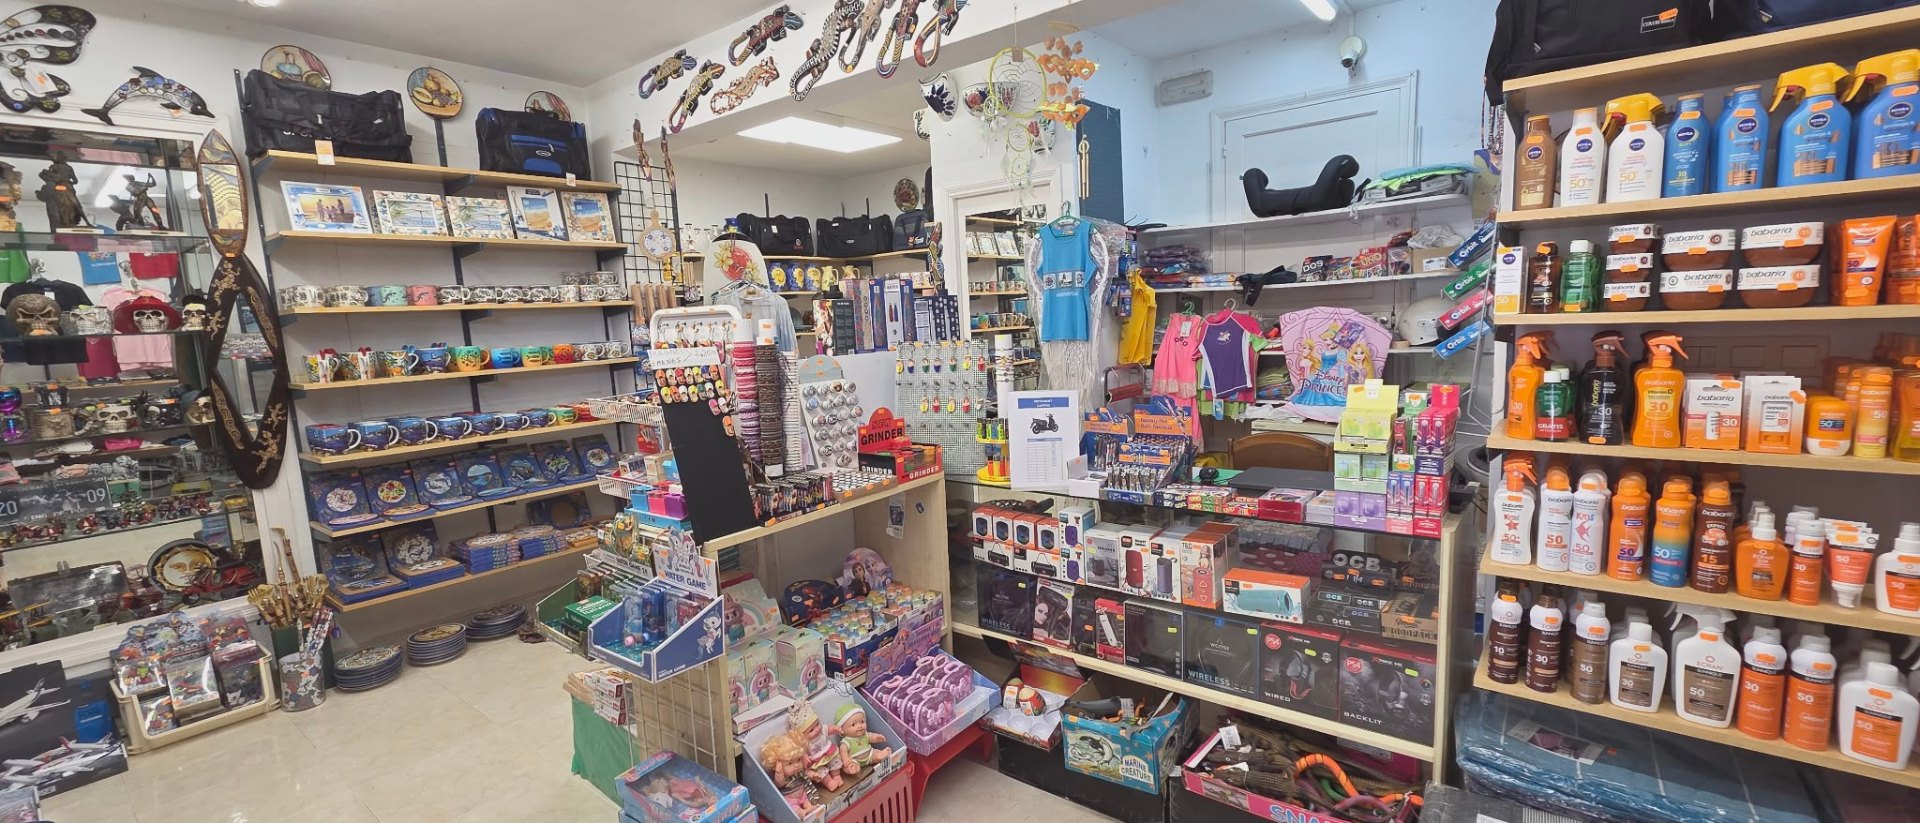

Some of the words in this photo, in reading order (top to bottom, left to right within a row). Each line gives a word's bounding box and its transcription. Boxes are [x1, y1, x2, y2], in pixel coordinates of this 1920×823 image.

[1750, 226, 1792, 237] babaria
[1668, 233, 1704, 243] babaria
[1460, 241, 1479, 258] Orbit
[1303, 260, 1324, 272] DOS
[1684, 271, 1722, 281] babaria
[1746, 269, 1786, 279] babaria
[1455, 275, 1475, 290] Orbit
[1451, 305, 1471, 320] Orbit
[1446, 336, 1466, 349] Orbit
[1592, 379, 1601, 407] babaria
[1697, 394, 1735, 402] babaria
[1649, 402, 1669, 412] 30
[1722, 418, 1737, 427] 30
[861, 428, 903, 446] GRINDER
[862, 465, 893, 476] GRINDER
[909, 465, 939, 479] GRINDER
[86, 488, 106, 503] 09
[1546, 535, 1563, 544] 50
[1619, 547, 1635, 556] 50
[1654, 546, 1669, 558] 50
[1333, 553, 1381, 571] OCB
[1701, 554, 1717, 564] 15
[1326, 593, 1342, 601] OCB
[1332, 618, 1351, 626] OCB
[1493, 645, 1505, 654] 10
[1535, 655, 1548, 664] 30
[1580, 664, 1593, 673] 50
[1696, 661, 1723, 670] ECRAN
[1188, 669, 1230, 686] WIRELESS
[1622, 678, 1634, 687] 30
[1689, 686, 1705, 697] 50
[1744, 681, 1759, 692] 30
[1264, 692, 1291, 702] WIRED
[1797, 692, 1813, 703] 50
[1344, 711, 1383, 725] BACKLIT
[1857, 720, 1873, 731] 50
[1124, 759, 1148, 773] MARINE
[1120, 767, 1152, 782] CREATURE
